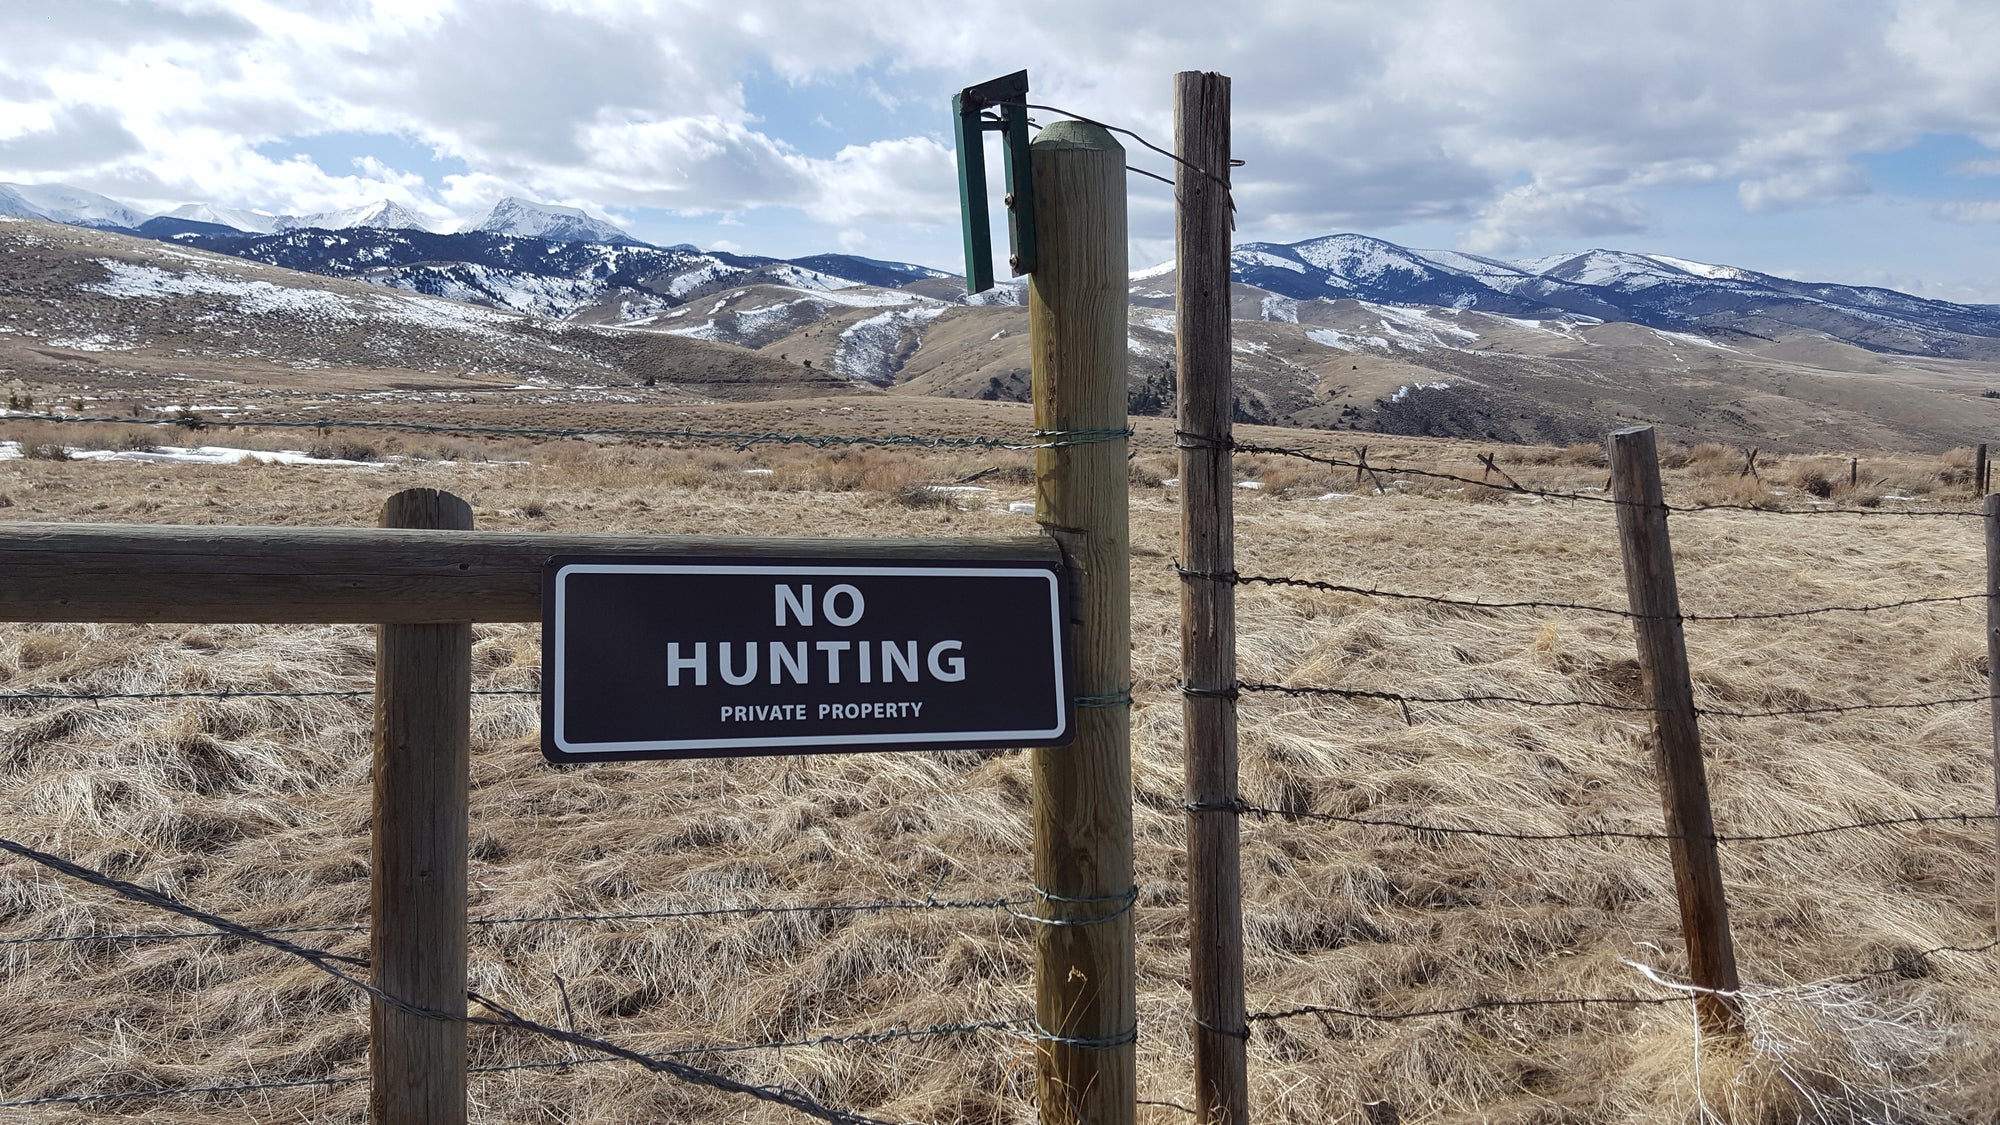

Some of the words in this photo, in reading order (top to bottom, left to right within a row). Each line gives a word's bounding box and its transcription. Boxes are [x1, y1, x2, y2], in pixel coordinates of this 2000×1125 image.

[774, 583, 866, 628] NO
[666, 640, 966, 687] HUNTING
[720, 704, 808, 723] PRIVATE
[817, 701, 923, 720] PROPERTY
